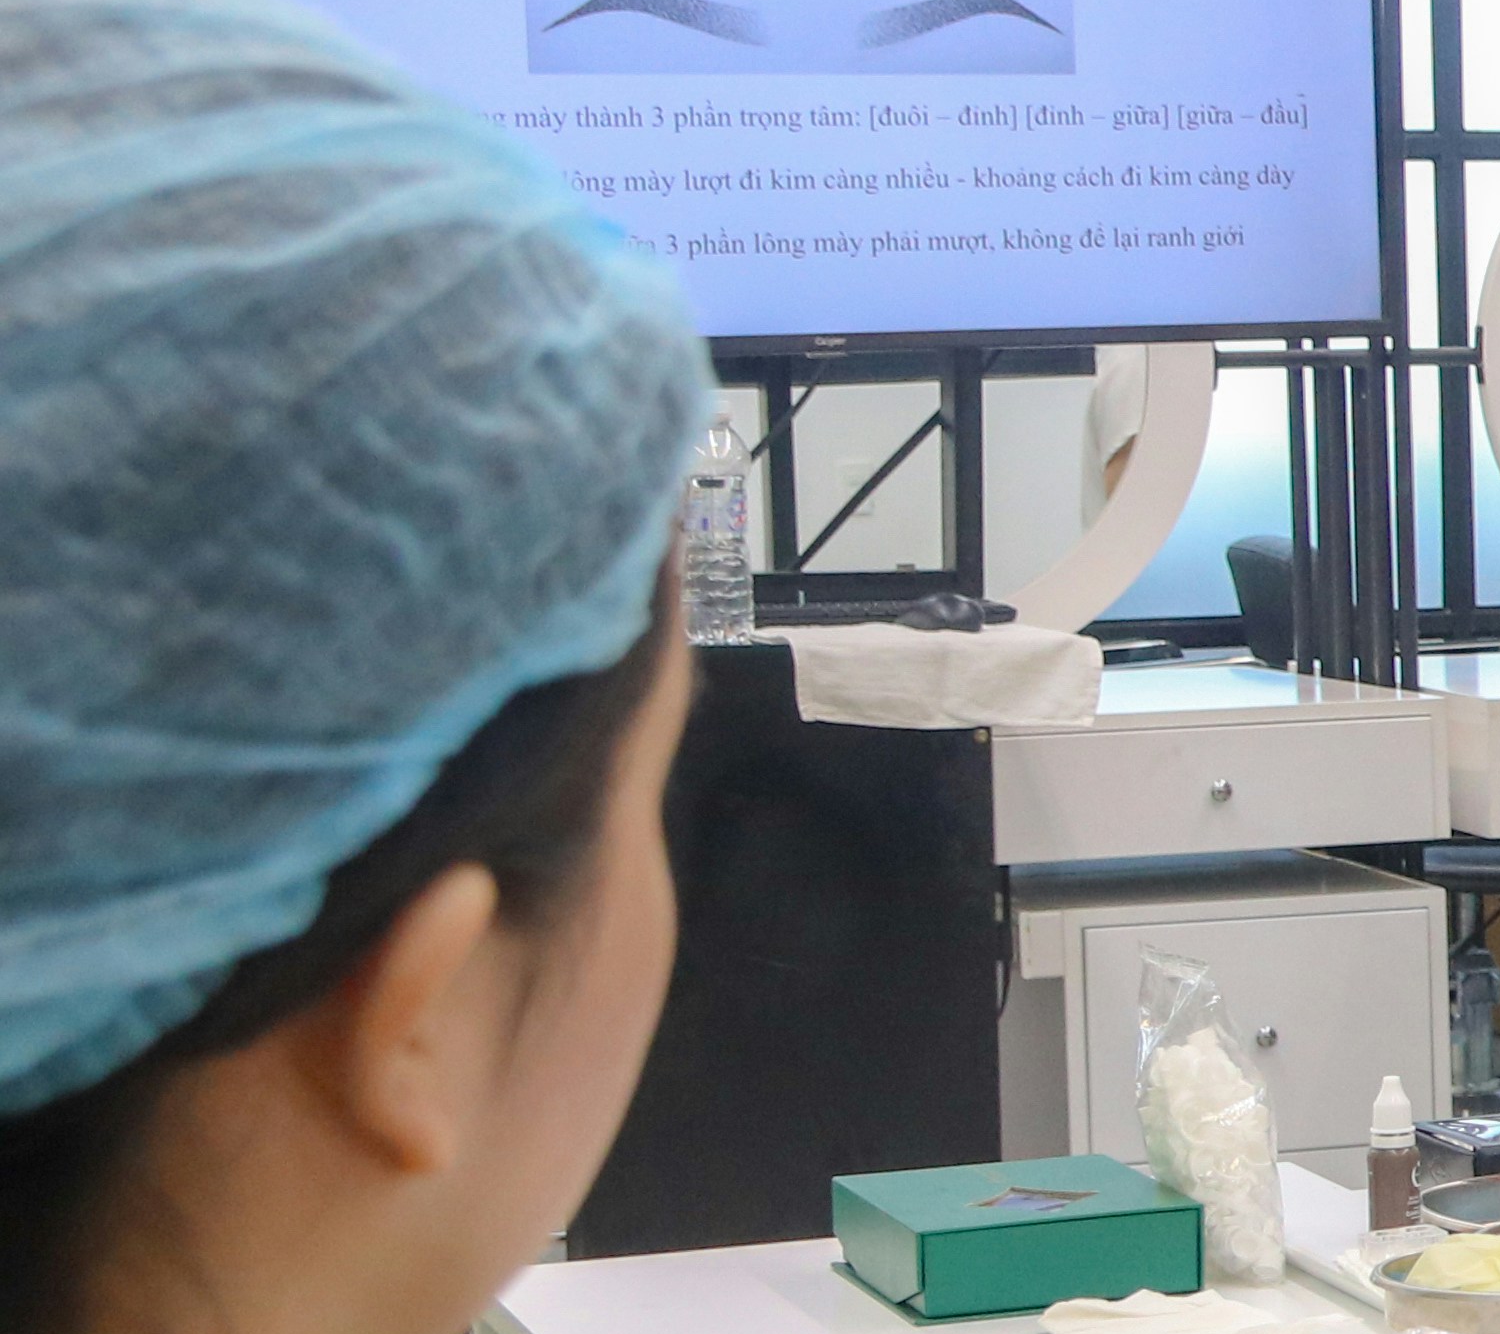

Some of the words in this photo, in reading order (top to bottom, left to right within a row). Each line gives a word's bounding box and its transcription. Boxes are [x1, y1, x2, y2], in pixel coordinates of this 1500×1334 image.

[514, 105, 567, 133] mày
[575, 104, 643, 129] thành
[651, 106, 665, 128] 3
[674, 98, 732, 133] phần
[739, 107, 802, 133] trọng
[810, 105, 861, 128] tâm:
[869, 104, 929, 131] [đuôi
[1112, 104, 1170, 131] giữa]
[1176, 104, 1234, 131] [giữa
[623, 169, 674, 196] mày
[683, 168, 731, 194] lượt
[738, 168, 762, 191] đi
[770, 168, 815, 191] kim
[823, 168, 879, 196] càng
[886, 160, 950, 190] nhiều
[973, 164, 1057, 193] khoảng
[1063, 164, 1115, 188] cách
[1121, 164, 1143, 187] đi
[1149, 163, 1192, 187] kim
[1198, 164, 1250, 191] càng
[1256, 164, 1295, 189] dày
[666, 234, 679, 256] 3
[688, 226, 746, 260] phần
[754, 233, 806, 259] lông
[813, 234, 864, 259] mày
[870, 231, 920, 258] phải
[1002, 227, 1073, 254] không
[1113, 227, 1140, 252] lại
[1147, 227, 1196, 248] ranh
[1202, 224, 1245, 251] giới
